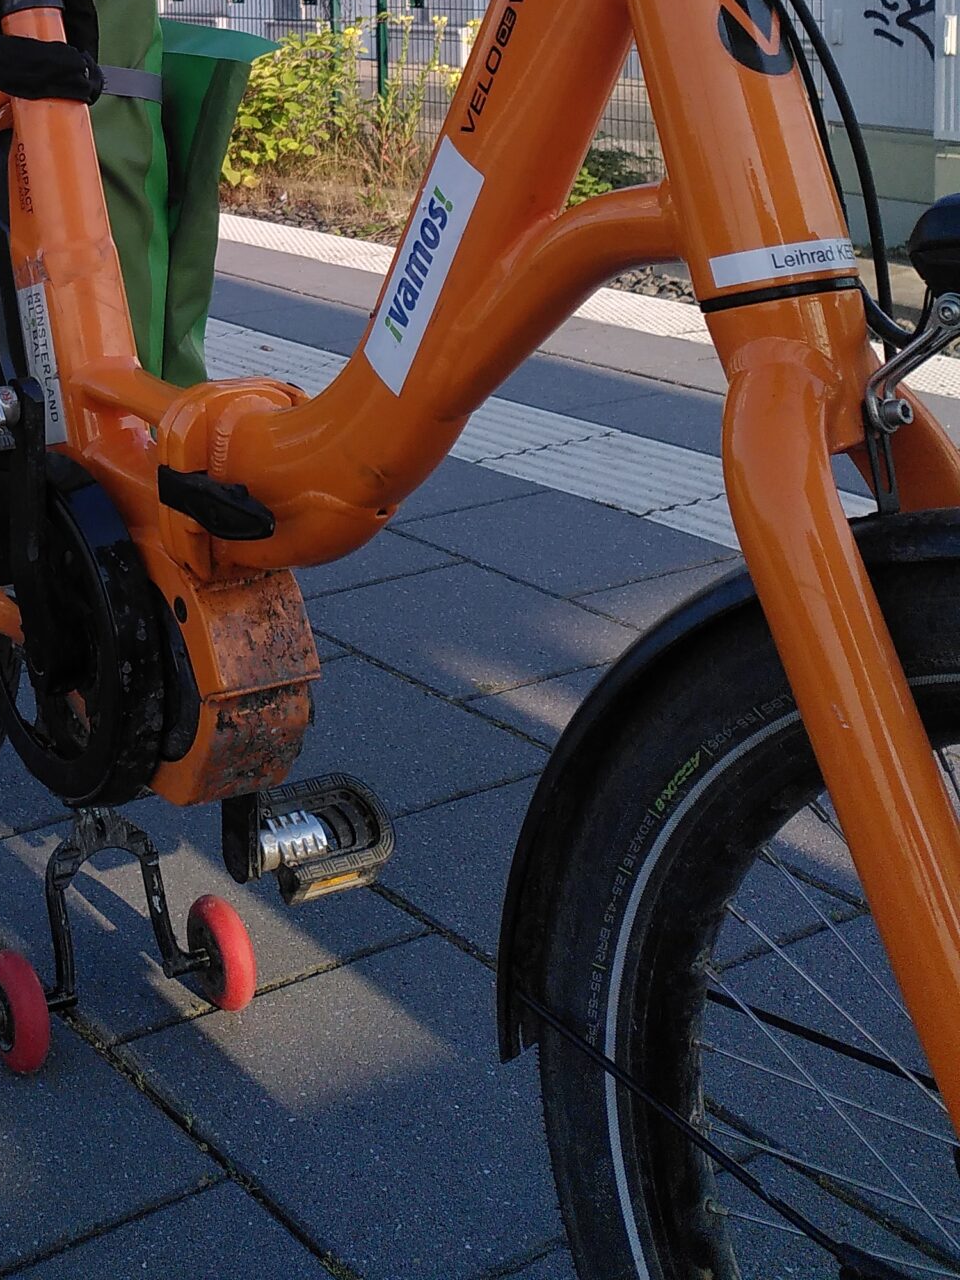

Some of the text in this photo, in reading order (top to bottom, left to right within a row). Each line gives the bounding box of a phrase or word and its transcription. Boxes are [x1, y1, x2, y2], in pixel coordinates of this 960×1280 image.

[17, 142, 34, 215] COMPACT
[771, 245, 835, 270] Leihrad
[33, 291, 59, 424] MÜNSTERLAND
